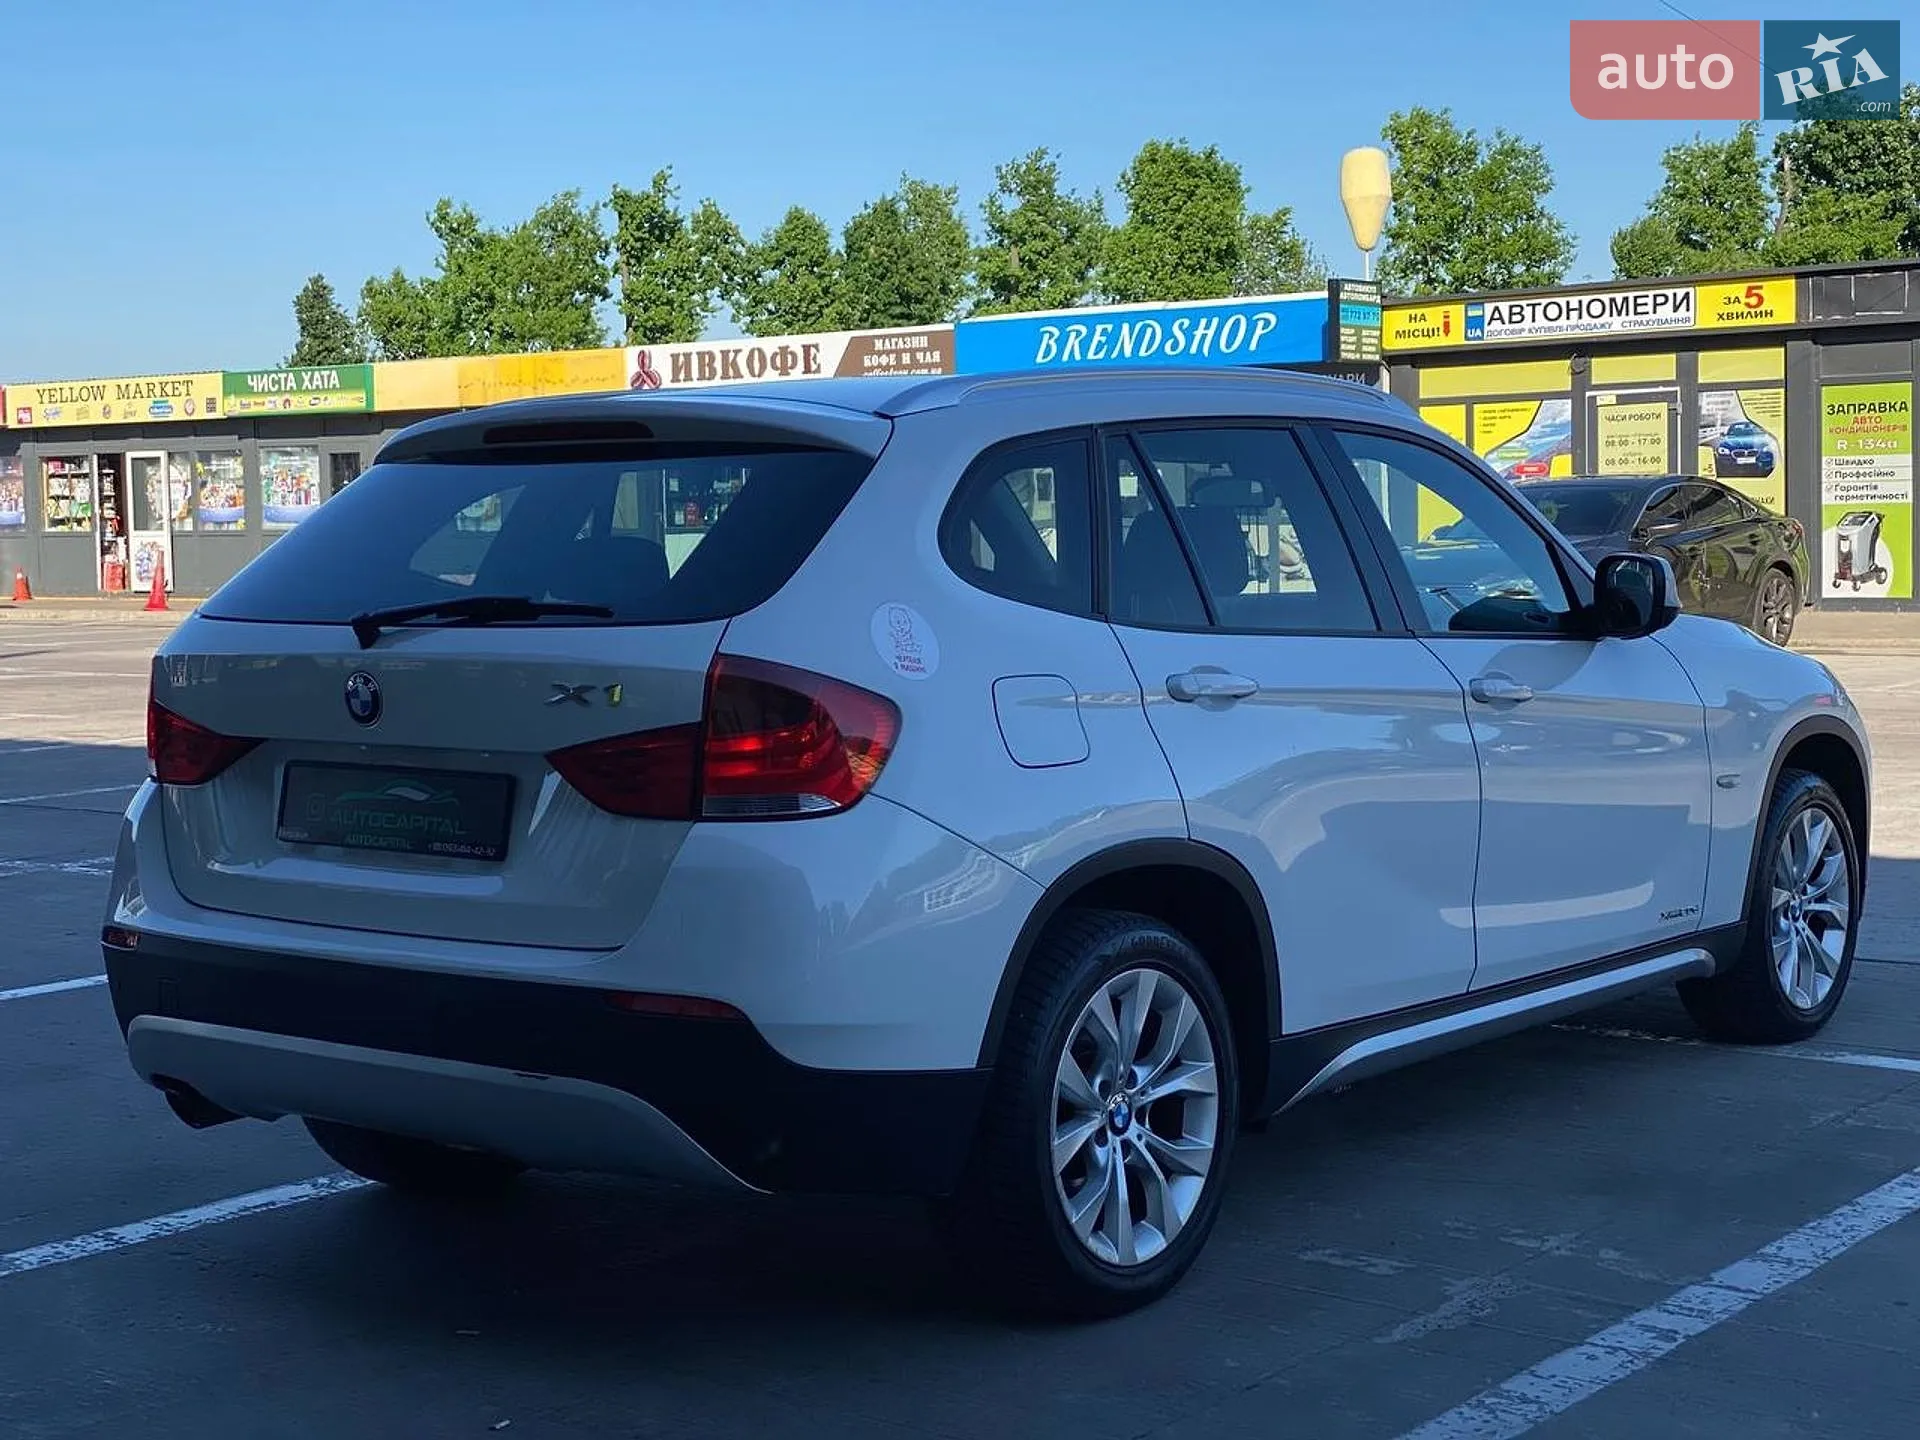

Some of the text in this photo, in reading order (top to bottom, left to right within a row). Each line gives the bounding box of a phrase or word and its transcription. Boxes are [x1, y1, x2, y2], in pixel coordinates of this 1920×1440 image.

[1723, 284, 1765, 310] ЗА 5
[1487, 291, 1692, 326] АВТОНОМЕРИ
[1716, 308, 1774, 322] ХВИЛИН
[1408, 312, 1428, 324] НА
[1620, 315, 1692, 329] СТРАХУВАННЯ
[1034, 311, 1278, 364] BRENDSHOP
[1395, 325, 1441, 340] МІСЦІ!
[1467, 327, 1483, 338] UA
[874, 336, 929, 351] МАГАЗИН
[669, 342, 823, 384] ИВКОФЕ
[863, 350, 941, 368] КОФЕ И ЧАЯ
[247, 369, 340, 393] ЧИСТА ХАТА
[36, 379, 194, 405] YELLOW MARKET
[1826, 401, 1909, 416] ЗАПРАВКА
[1604, 412, 1662, 423] ЧАСИ РОБОТИ
[1852, 415, 1883, 425] АВТО
[1834, 458, 1875, 466] Швидко
[1834, 469, 1896, 479] Професійно
[543, 682, 624, 708] X1
